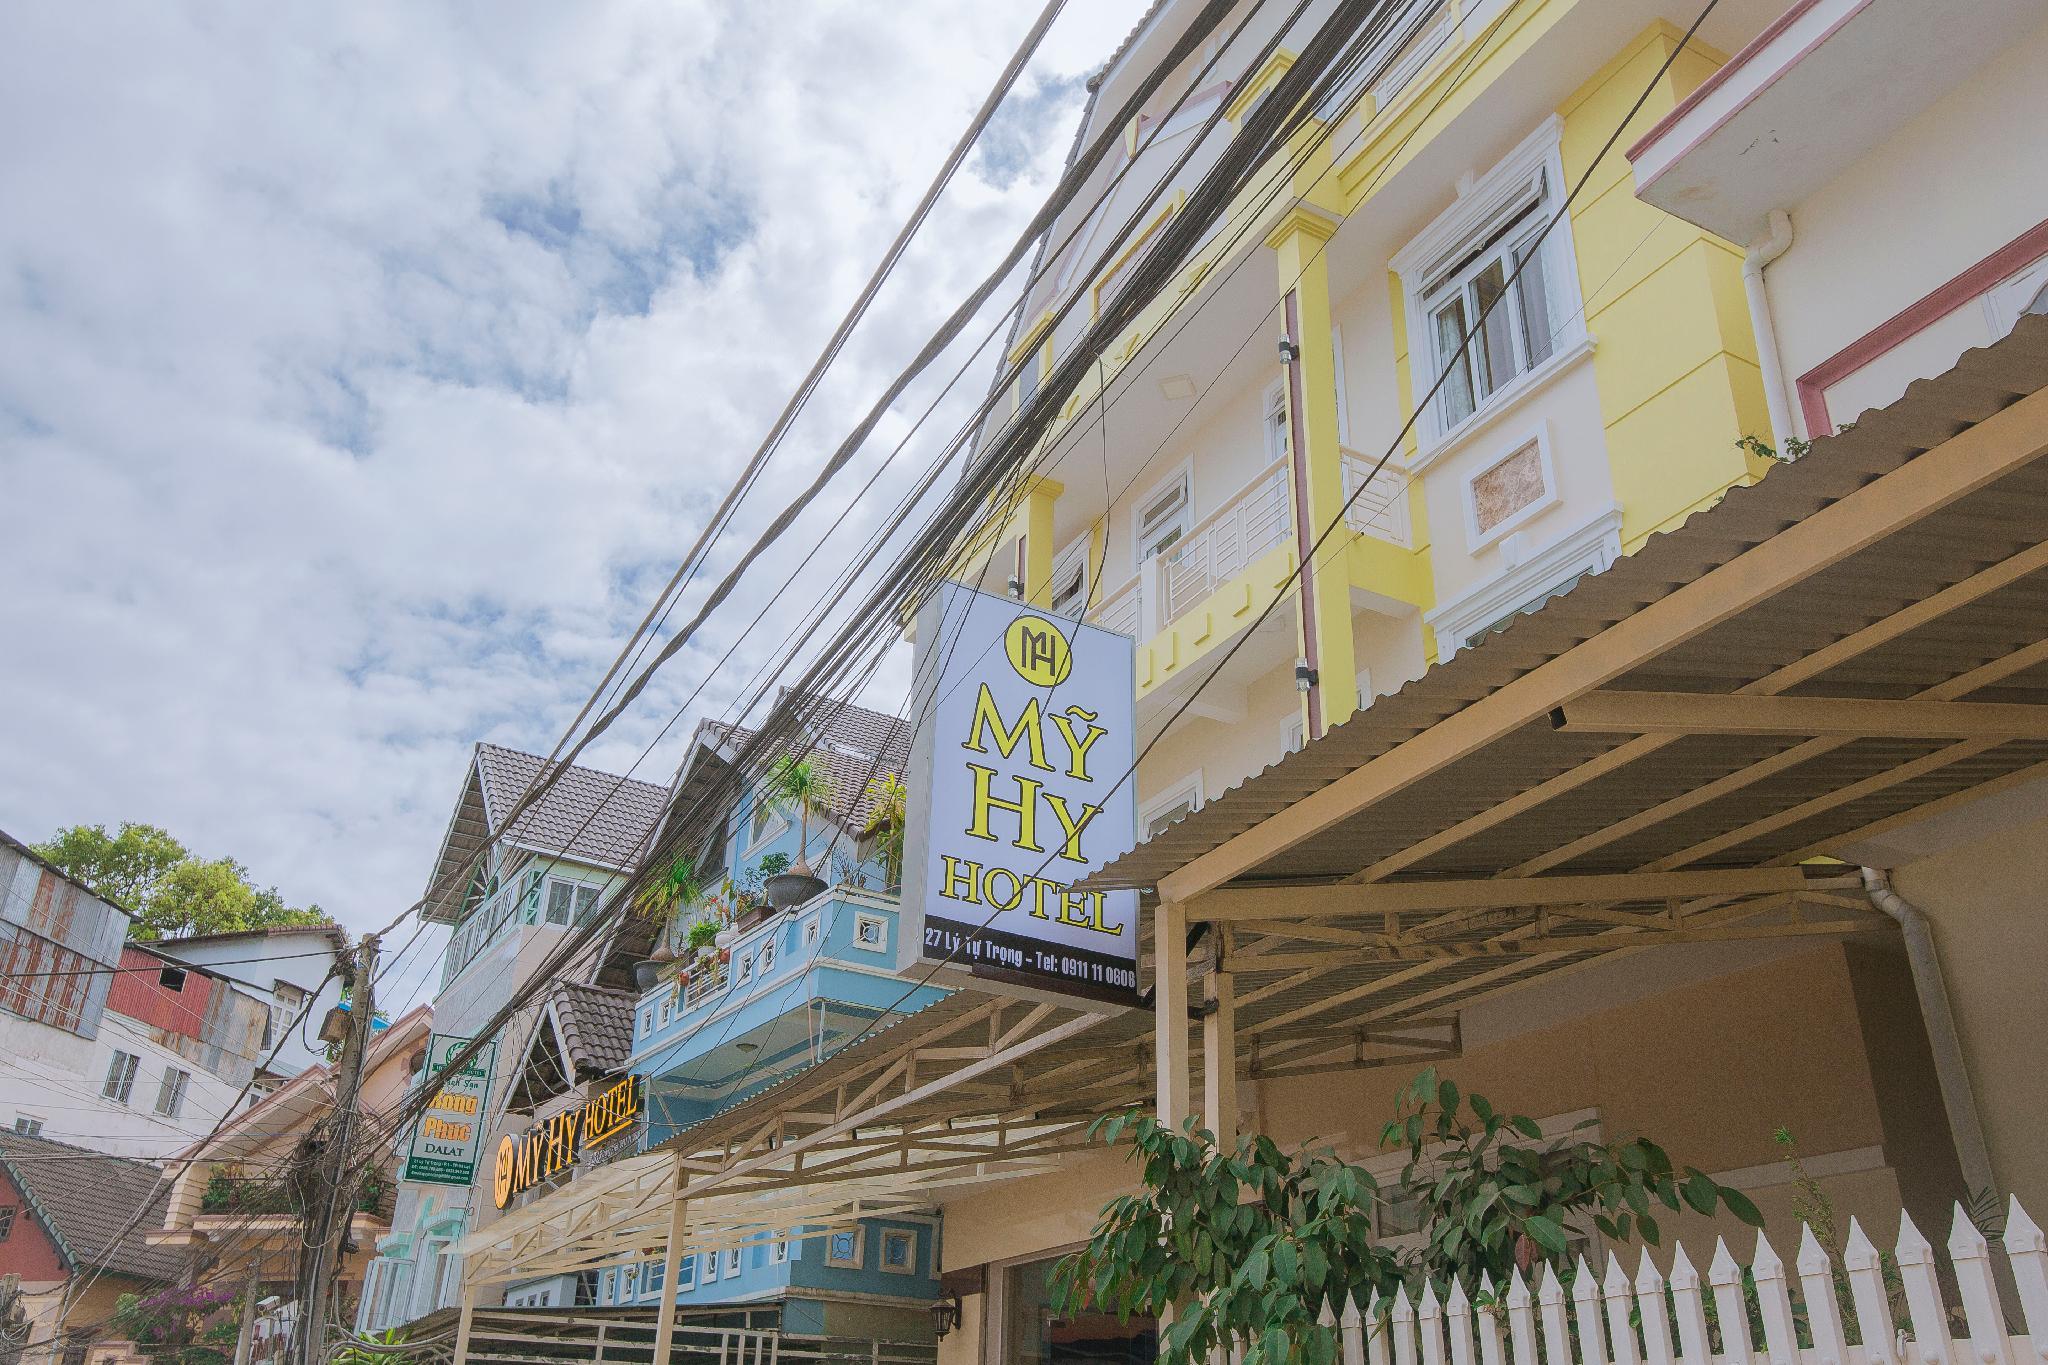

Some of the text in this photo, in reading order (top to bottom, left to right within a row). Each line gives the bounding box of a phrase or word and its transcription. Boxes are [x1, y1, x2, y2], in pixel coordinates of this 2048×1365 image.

[961, 682, 1108, 782] MỸ
[964, 762, 1104, 863] HY
[939, 854, 1124, 936] HOTEL
[925, 927, 942, 946] 27
[945, 931, 960, 954] Lý
[985, 940, 1023, 968] Trọng
[1035, 951, 1058, 973] Tel:
[1061, 956, 1088, 979] 0911
[1091, 963, 1103, 982] 11
[424, 1142, 464, 1157] DALAT
[545, 1110, 581, 1177] HY
[583, 1075, 638, 1142] HOTEL
